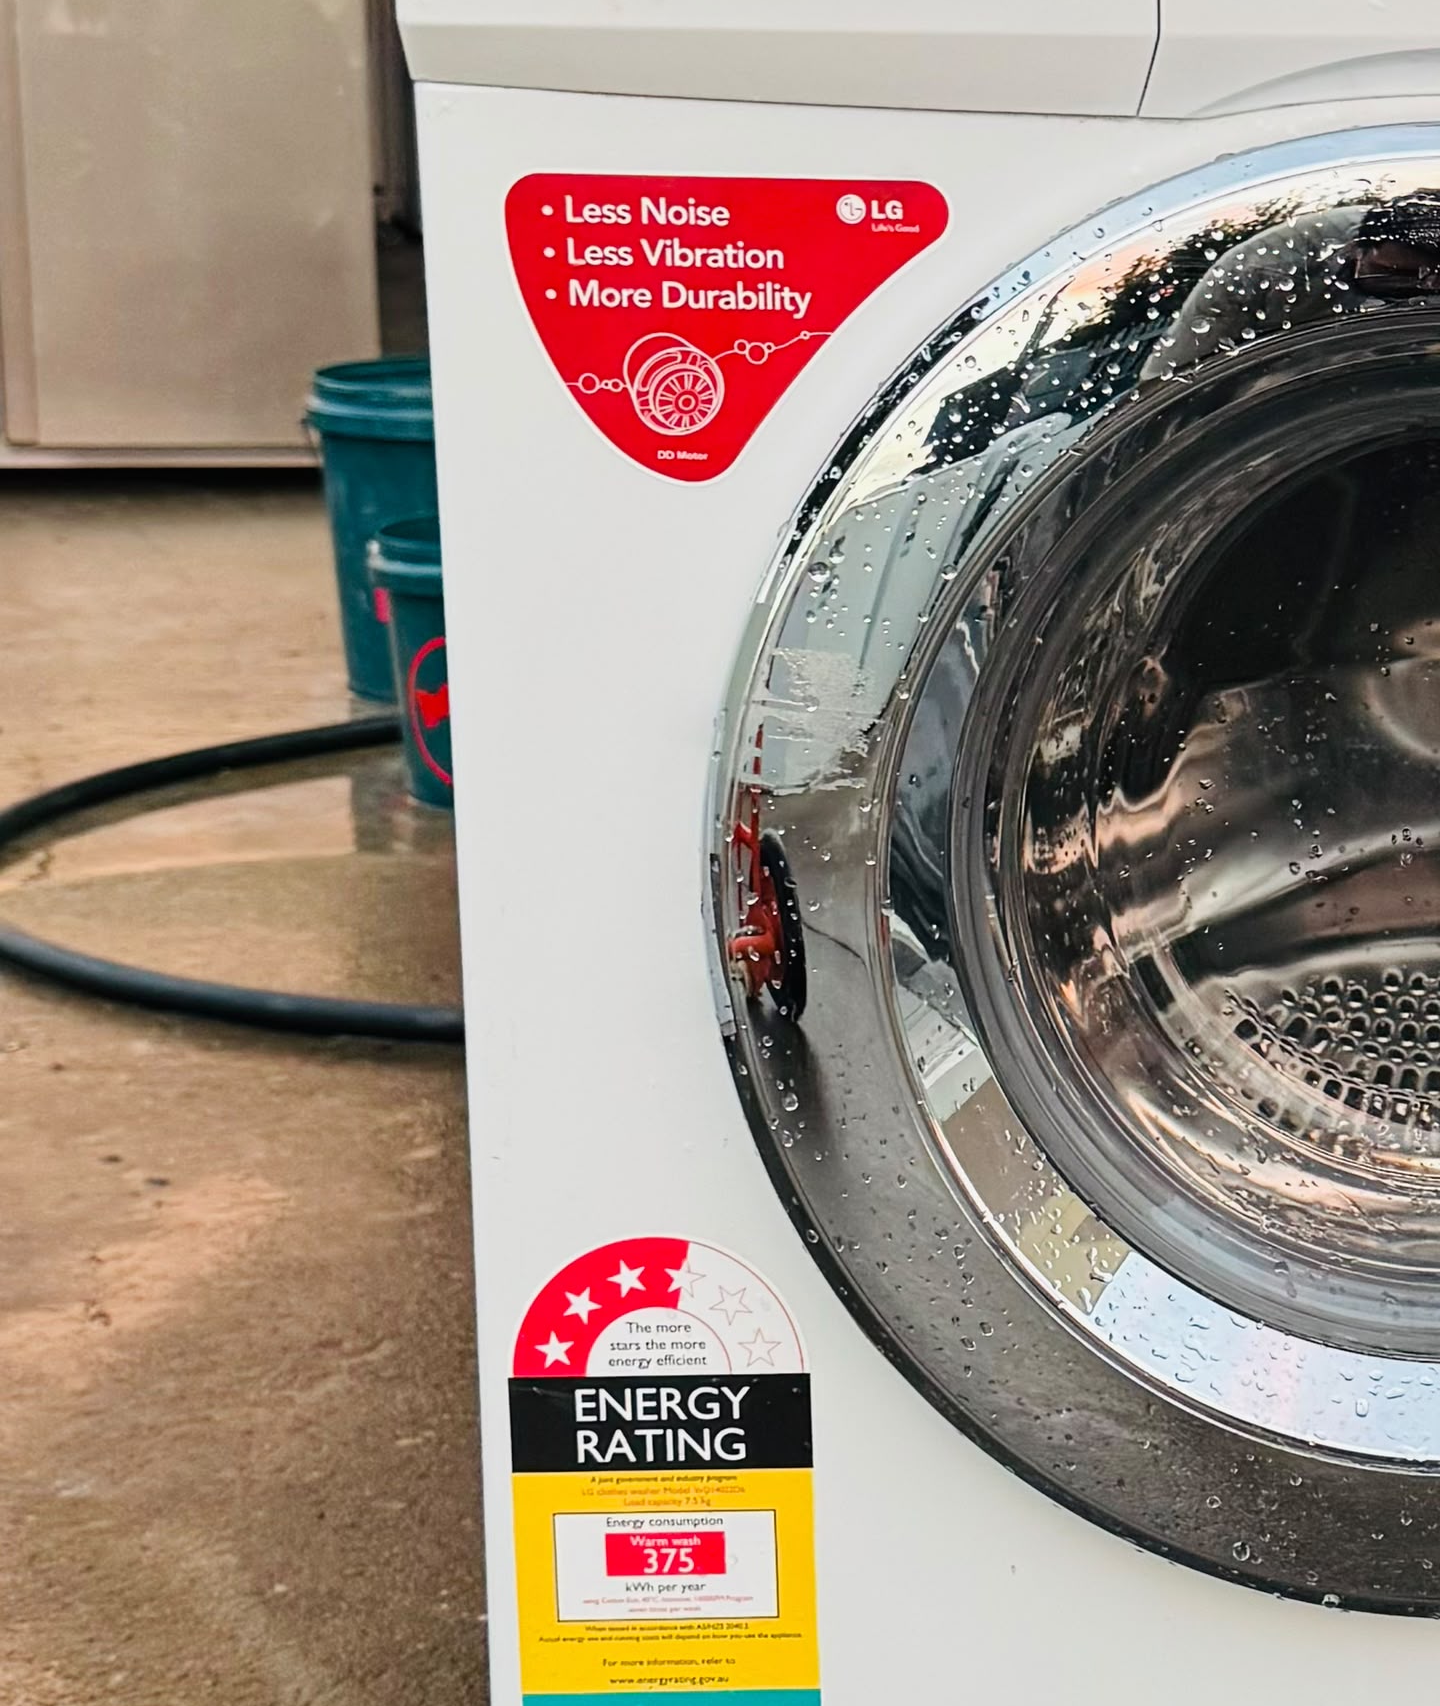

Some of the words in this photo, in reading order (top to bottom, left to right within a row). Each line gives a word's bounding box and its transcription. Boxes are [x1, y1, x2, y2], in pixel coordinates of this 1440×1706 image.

[565, 194, 631, 224] Less
[641, 196, 730, 227] Noise
[870, 199, 904, 220] LG
[566, 238, 634, 267] Less
[641, 238, 785, 270] Vibration
[568, 279, 653, 309] More
[662, 281, 812, 319] Durability
[657, 449, 675, 460] DD
[676, 450, 709, 461] Motor
[625, 1321, 652, 1334] The
[656, 1323, 692, 1333] more
[609, 1341, 642, 1351] stars
[645, 1339, 668, 1350] the
[670, 1341, 707, 1350] more
[608, 1357, 652, 1370] energy
[656, 1355, 708, 1367] efficient
[575, 1385, 750, 1423] ENERGY
[576, 1427, 747, 1464] RATING
[606, 1516, 645, 1530] Energy
[648, 1515, 724, 1530] consumption
[629, 1536, 669, 1547] Warm
[672, 1535, 702, 1547] wash
[642, 1547, 696, 1574] 375
[625, 1581, 654, 1592] kWh
[657, 1583, 677, 1595] per
[681, 1582, 707, 1594] year
